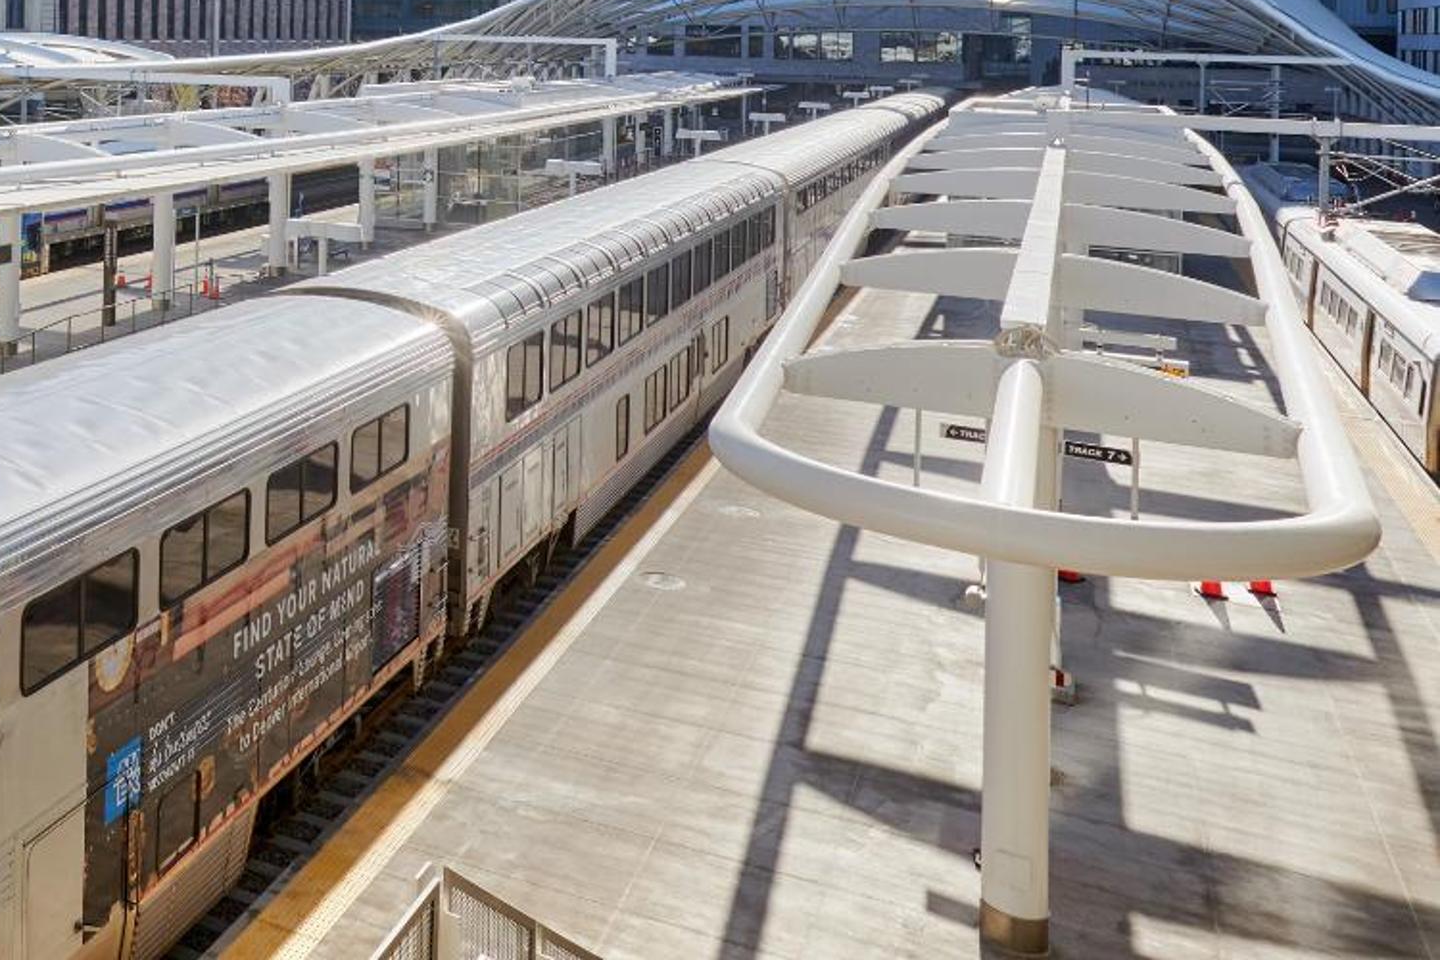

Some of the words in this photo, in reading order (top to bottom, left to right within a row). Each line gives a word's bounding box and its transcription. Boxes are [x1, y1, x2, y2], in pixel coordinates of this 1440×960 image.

[959, 429, 986, 441] TRAC
[1068, 444, 1103, 458] TRACK
[1107, 449, 1117, 460] 7
[232, 609, 272, 659] FIND
[276, 579, 317, 625] YOUR
[321, 539, 381, 595] NATURAL
[254, 623, 303, 680] STATE
[306, 605, 327, 639] OF
[329, 579, 365, 621] MIND
